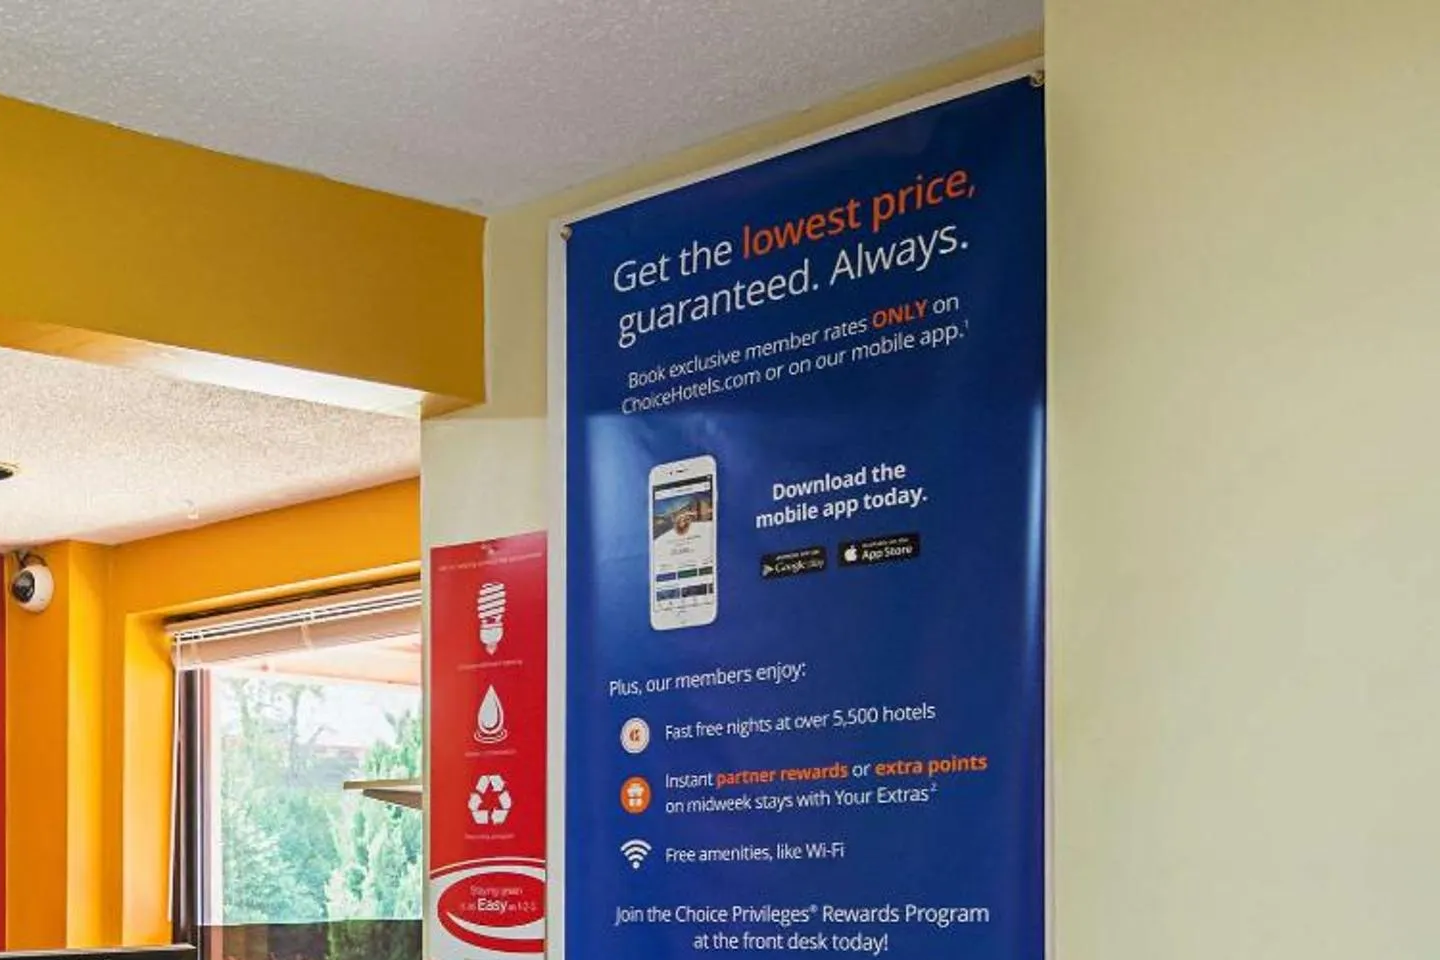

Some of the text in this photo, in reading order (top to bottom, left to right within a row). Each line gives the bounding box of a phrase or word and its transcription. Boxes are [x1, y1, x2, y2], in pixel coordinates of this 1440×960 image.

[613, 168, 977, 294] Get the lowest price,
[618, 222, 969, 348] guaranteed. Always.
[628, 296, 959, 389] Book exclusive member rates ONLY on
[621, 368, 761, 415] ChoiceHotels.com
[765, 363, 783, 381] or
[788, 357, 811, 376] on
[815, 349, 845, 370] our
[852, 331, 915, 360] mobile
[772, 463, 906, 501] Download the
[755, 485, 928, 530] mobile app today.
[862, 545, 913, 561] App Store
[609, 662, 807, 696] Plus, our members enjoy:
[665, 703, 935, 741] Fast free nights at over 5,500 hotels
[666, 755, 988, 788] Instant partner rewards or extra points
[666, 798, 684, 813] on
[687, 792, 752, 812] midweek
[755, 793, 794, 811] stays
[796, 788, 831, 807] with
[834, 788, 872, 805] Your
[666, 842, 844, 863] Free amenities, like Wi-Fi
[477, 898, 507, 914] Easy
[615, 906, 644, 926] Join
[646, 907, 672, 923] the
[675, 907, 729, 923] Choice
[822, 905, 900, 924] Rewards
[905, 905, 990, 929] Program
[693, 933, 889, 955] at the front desk today!
